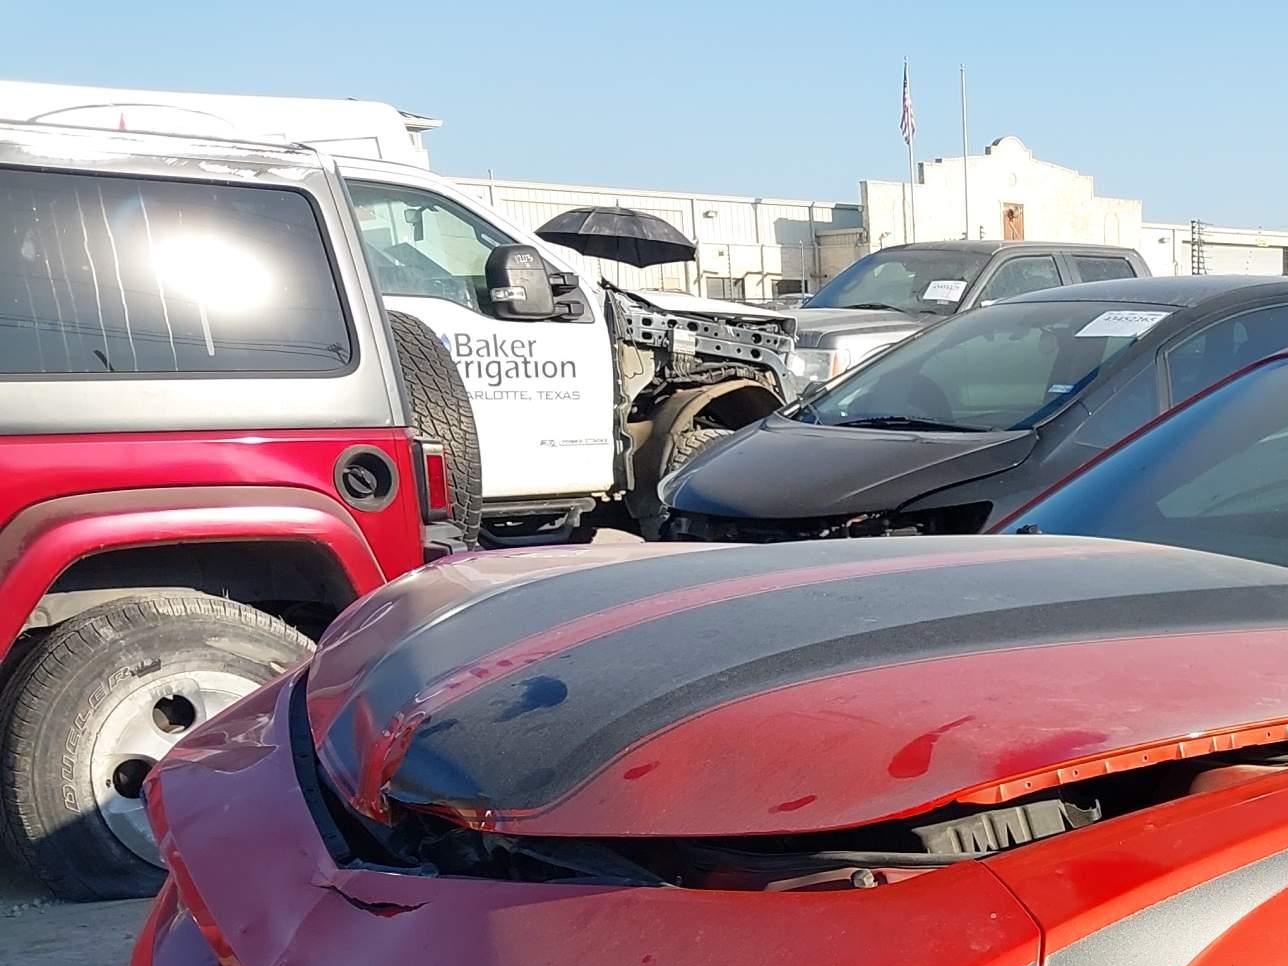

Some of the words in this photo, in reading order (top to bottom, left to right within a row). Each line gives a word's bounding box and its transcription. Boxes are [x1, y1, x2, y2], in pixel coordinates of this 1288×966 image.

[454, 333, 537, 358] Baker
[466, 390, 533, 401] ARLOTTE,
[536, 390, 581, 401] TEXAS
[61, 666, 130, 813] DUELER
